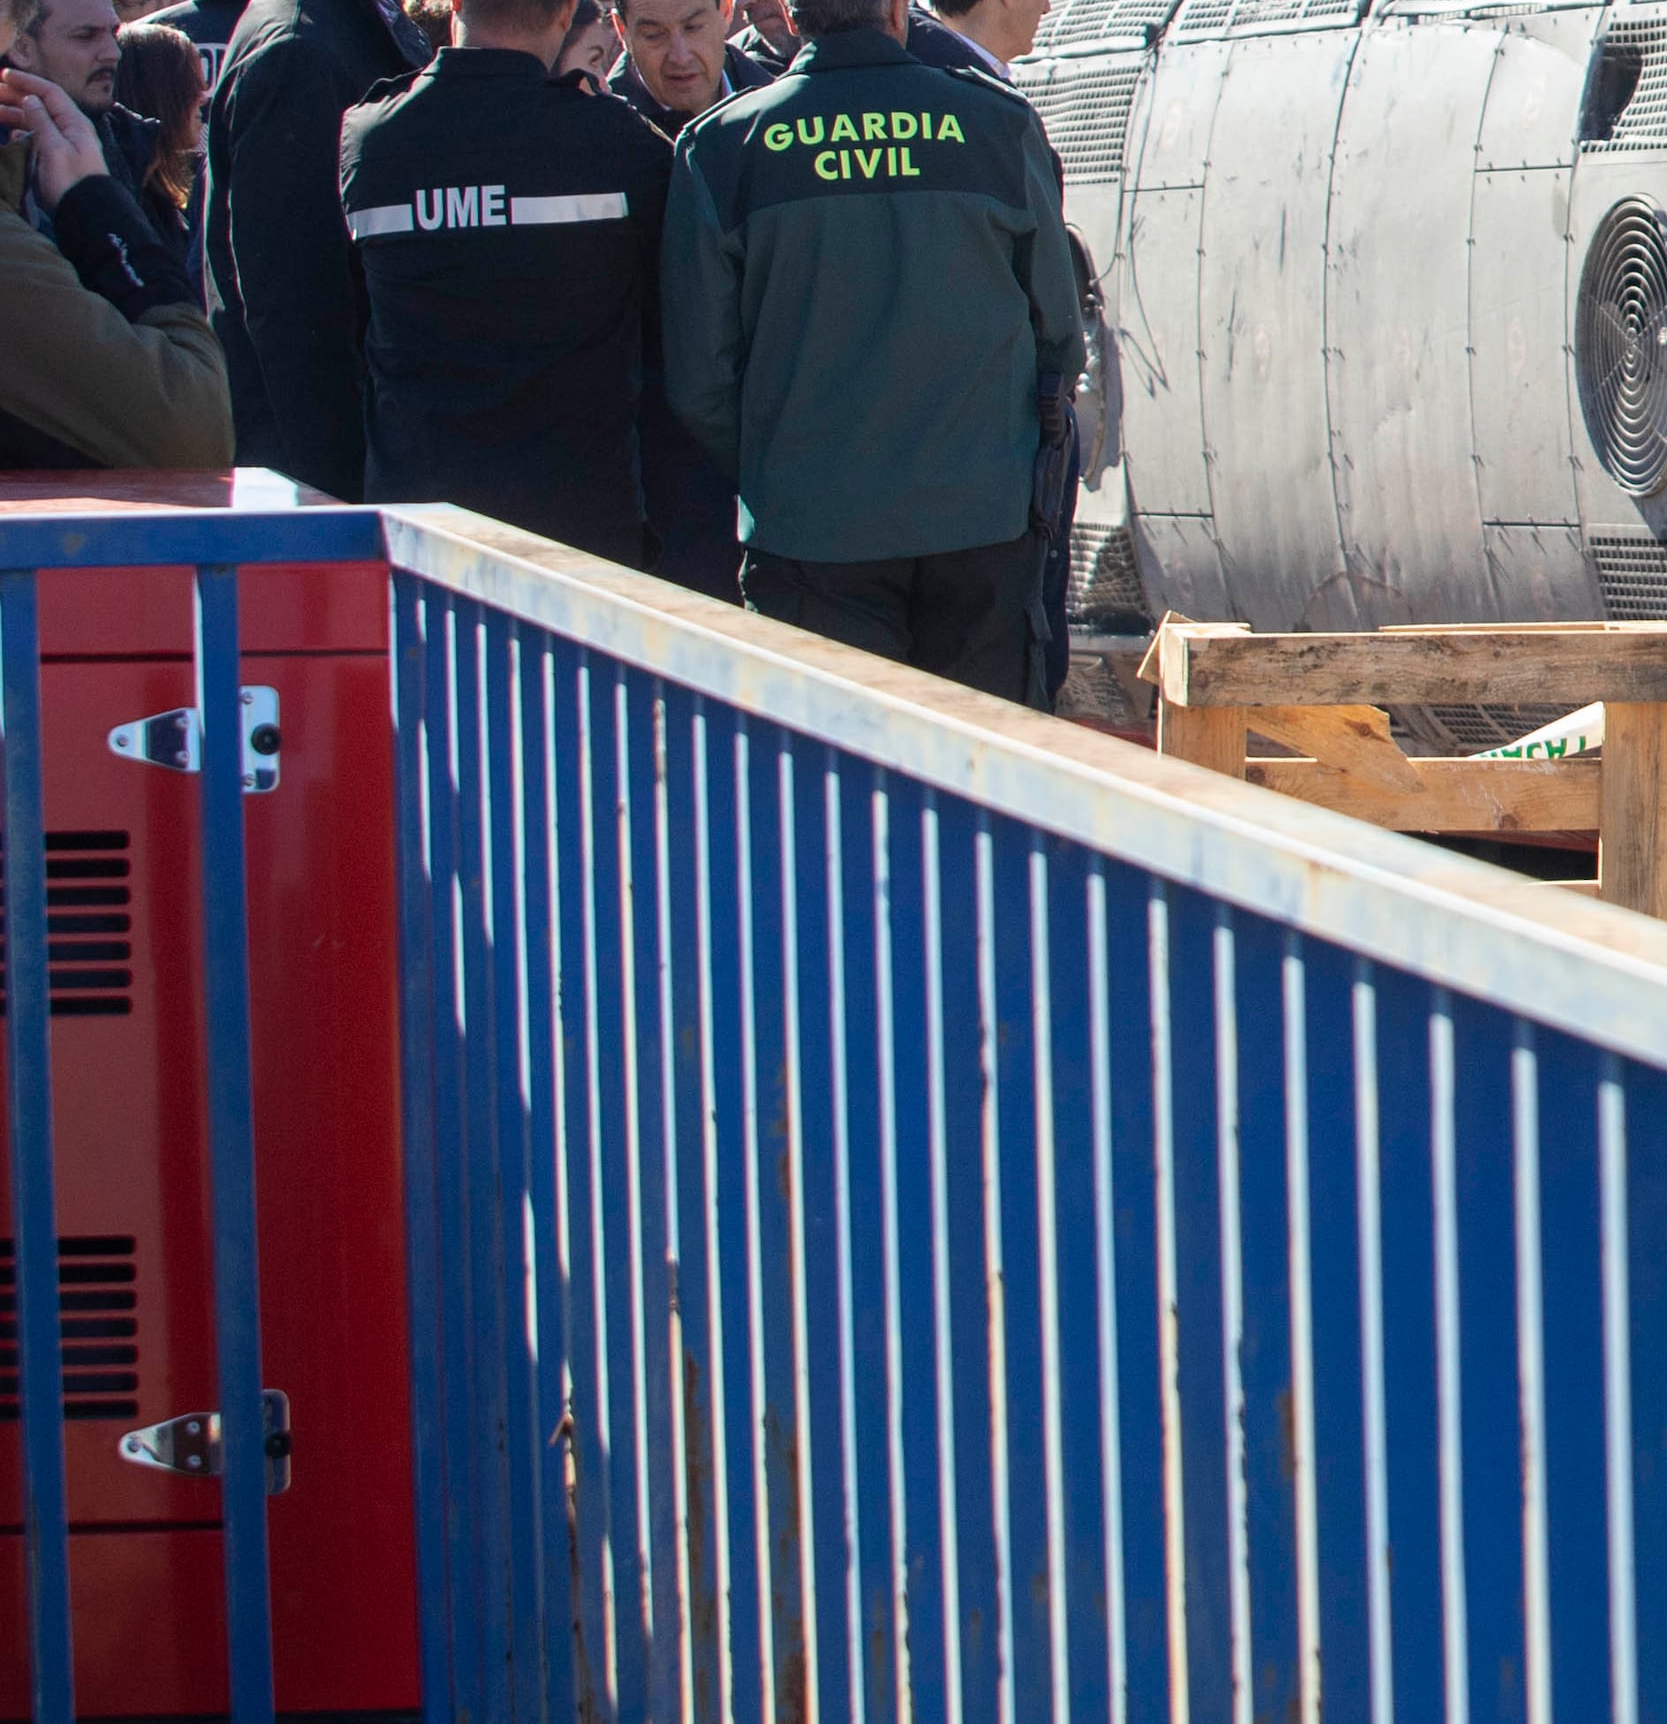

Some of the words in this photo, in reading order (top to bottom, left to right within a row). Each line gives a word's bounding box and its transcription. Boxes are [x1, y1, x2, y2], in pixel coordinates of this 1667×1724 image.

[763, 111, 966, 152] GUARDIA
[814, 146, 920, 181] CIVIL
[415, 184, 507, 231] UME
